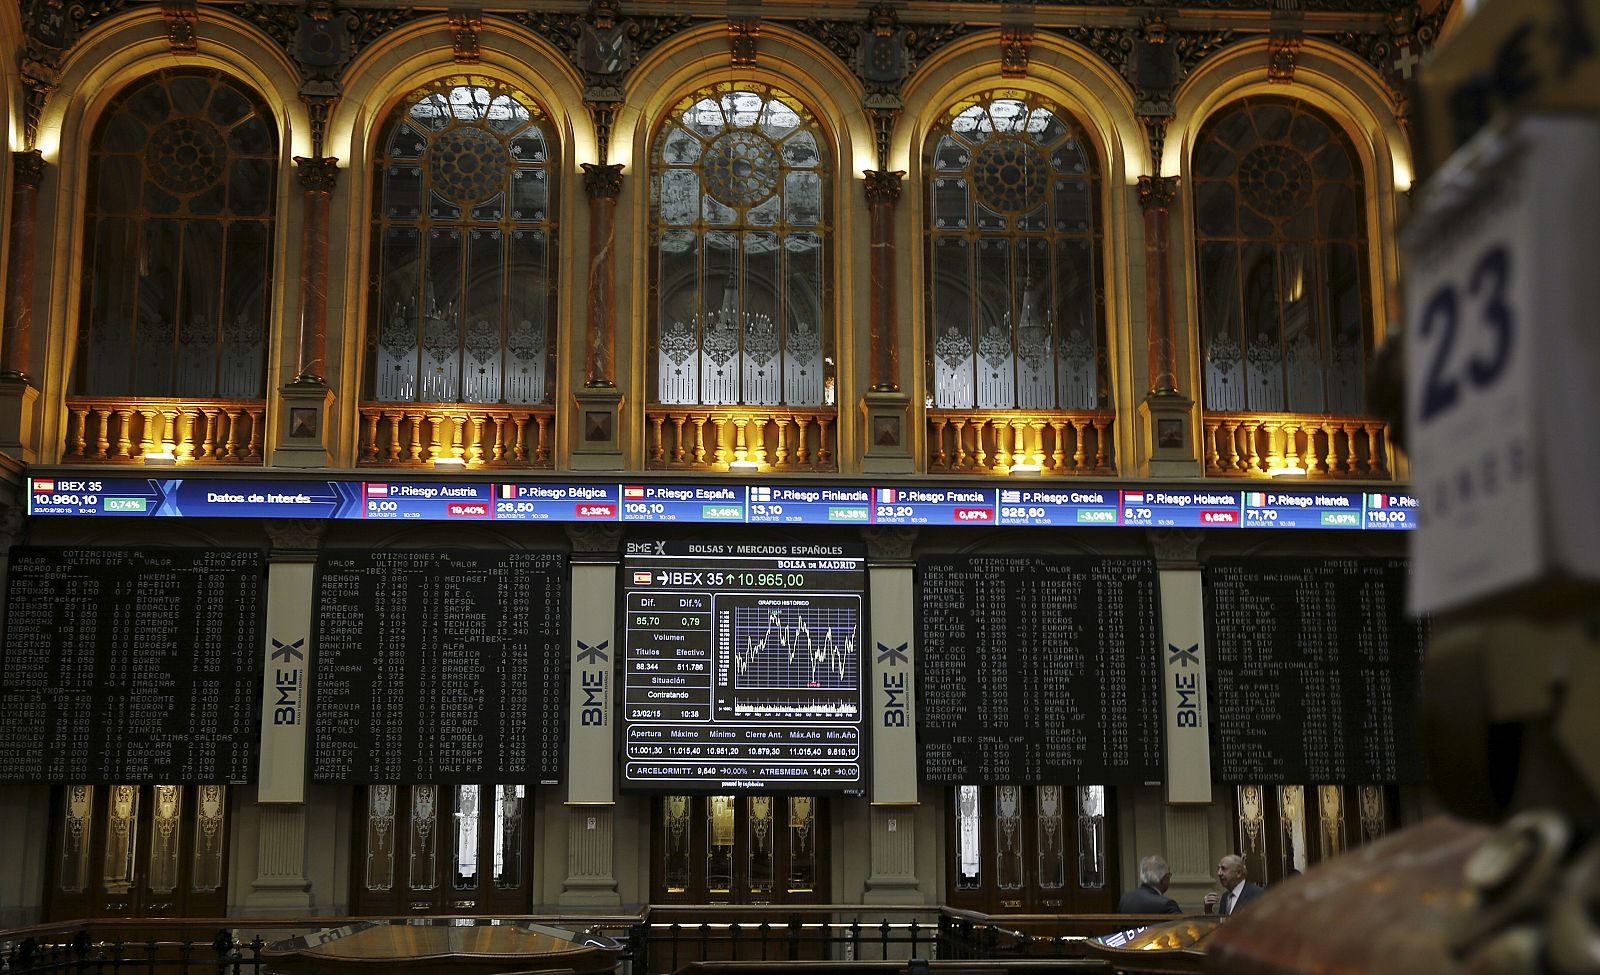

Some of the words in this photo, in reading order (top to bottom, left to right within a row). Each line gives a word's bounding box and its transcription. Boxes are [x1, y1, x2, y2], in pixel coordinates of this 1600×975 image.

[1418, 246, 1514, 420] 23
[58, 481, 85, 492] IBEX
[88, 481, 102, 492] 35
[390, 486, 438, 498] P.Riesgo
[440, 486, 478, 496] Austria
[519, 487, 566, 499] P.Riesgo
[569, 487, 607, 499] Bélgica
[646, 488, 694, 500] P.Riesgo
[696, 489, 736, 501] España
[773, 490, 820, 502] P.Riesgo
[822, 490, 868, 501] Finlandia
[898, 491, 944, 503] P.Riesgo
[947, 492, 984, 502] Francia
[207, 493, 245, 503] Datos
[248, 493, 264, 503] de
[268, 494, 311, 504] Interés
[1023, 492, 1068, 504] P.Riesgo
[1071, 493, 1104, 503] Grecia
[1146, 494, 1191, 506] P.Riesgo
[1194, 494, 1235, 505] Holanda
[1268, 495, 1313, 508] P.Riesgo
[1315, 496, 1349, 507] Irlanda
[110, 500, 140, 509] 0,74%
[368, 502, 397, 512] 8,00
[751, 505, 783, 516] 13,10
[877, 506, 913, 517] 23,20
[1246, 510, 1277, 521] 71,70
[62, 550, 129, 558] COTIZACIONES
[627, 543, 652, 553] BME
[689, 545, 724, 554] BOLSAS
[727, 545, 733, 554] Y
[737, 545, 787, 554] MERCADOS
[791, 544, 843, 555] ESPAÑOLES
[778, 561, 806, 569] BOLSA
[818, 561, 857, 569] MADRID
[969, 558, 1031, 566] COTIZACIONES
[669, 572, 703, 585] IBEX
[706, 572, 723, 586] 35
[738, 574, 804, 588] 10.965,00
[322, 582, 360, 590] ABERTIS
[641, 599, 656, 607] Dif.
[679, 599, 702, 608] Dif.%
[636, 617, 660, 626] 85,70
[681, 617, 700, 627] 0,79
[651, 676, 685, 684] Situación
[273, 669, 297, 725] BME
[582, 670, 603, 726] BME
[648, 691, 689, 699] Contratando
[883, 672, 905, 728] BME
[1176, 673, 1197, 728] BME
[632, 710, 661, 718] 23/02/15
[681, 710, 699, 718] 10:38
[631, 730, 662, 738] Apertura
[670, 730, 699, 738] Máximo
[630, 746, 663, 755] 11.001,30
[668, 747, 701, 755] 11.015,40
[706, 747, 739, 755] 10.951,20
[637, 767, 693, 775] ARCELORMITT.
[759, 768, 808, 776] ATRESMEDIA
[812, 768, 831, 776] 14,01
